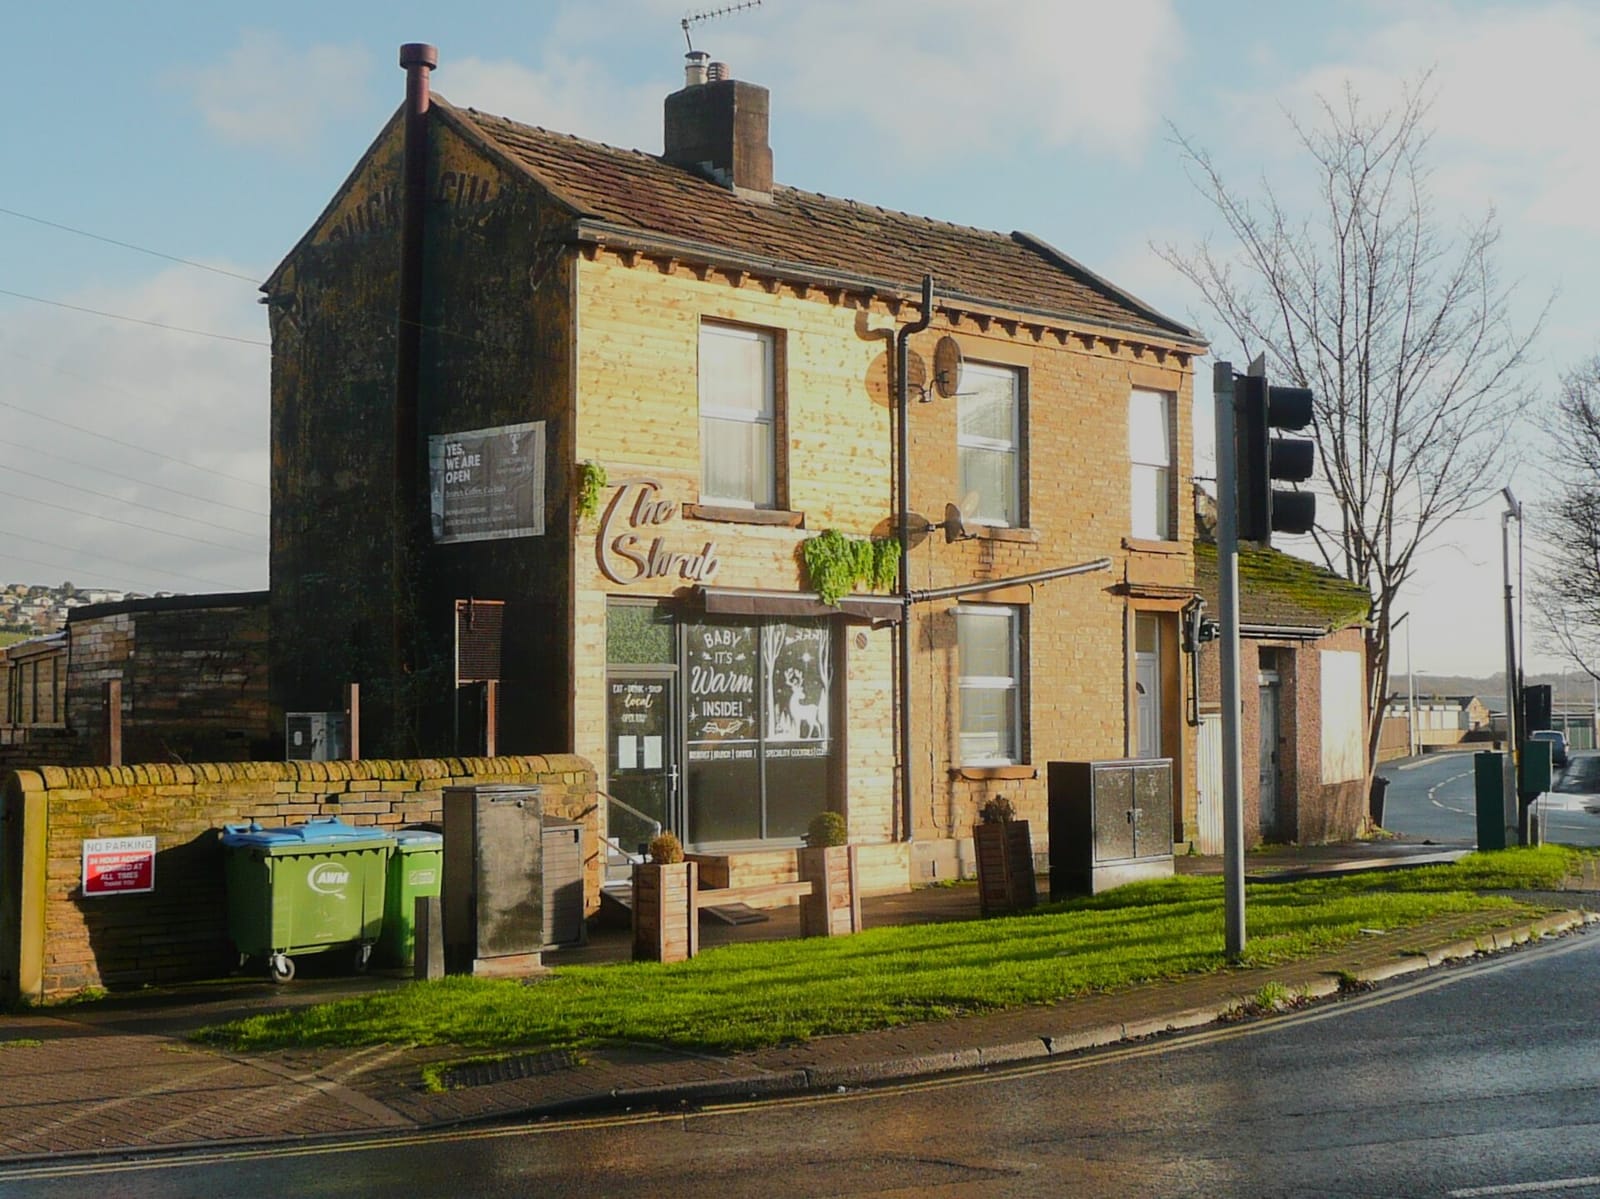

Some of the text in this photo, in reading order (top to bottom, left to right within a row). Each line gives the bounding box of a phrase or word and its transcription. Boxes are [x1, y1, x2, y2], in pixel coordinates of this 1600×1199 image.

[446, 443, 465, 456] YES,
[446, 455, 481, 470] WE ARE
[446, 470, 471, 484] OPEN
[611, 533, 721, 582] Shrub
[703, 630, 742, 649] BABY
[714, 652, 733, 665] IT'S
[691, 666, 754, 695] Warm
[702, 701, 743, 718] INSIDE!
[87, 840, 153, 852] NO PARKING
[100, 871, 139, 881] ALL TIMES
[317, 871, 349, 884] AWM
